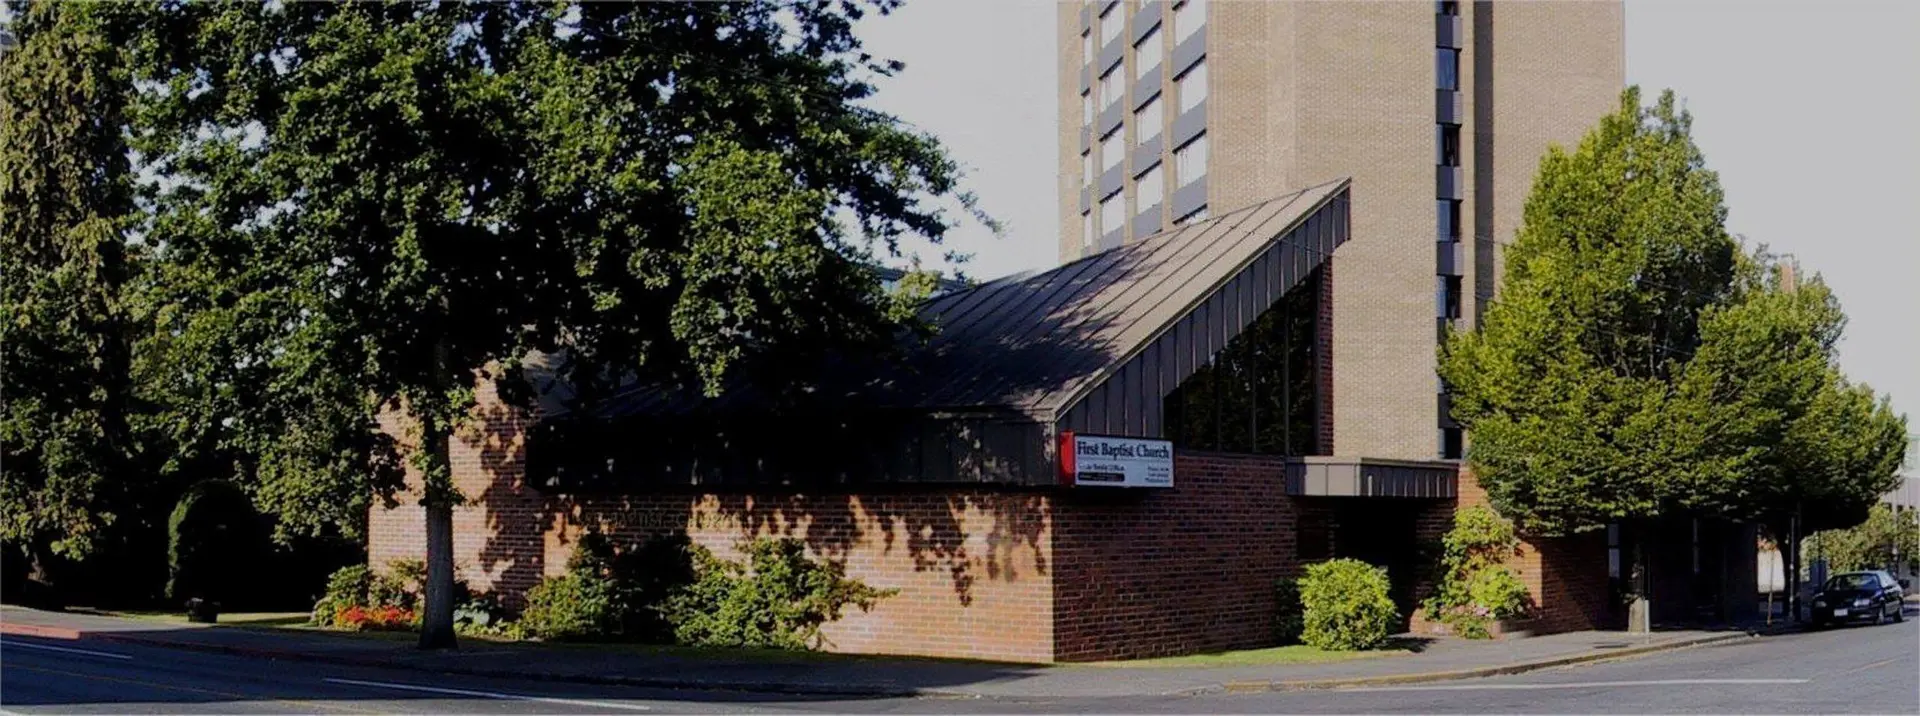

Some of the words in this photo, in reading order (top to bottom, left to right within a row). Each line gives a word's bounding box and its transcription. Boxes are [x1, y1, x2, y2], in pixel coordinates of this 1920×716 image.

[1077, 441, 1099, 456] First
[1102, 443, 1134, 460] Baptist
[1136, 444, 1170, 459] Church
